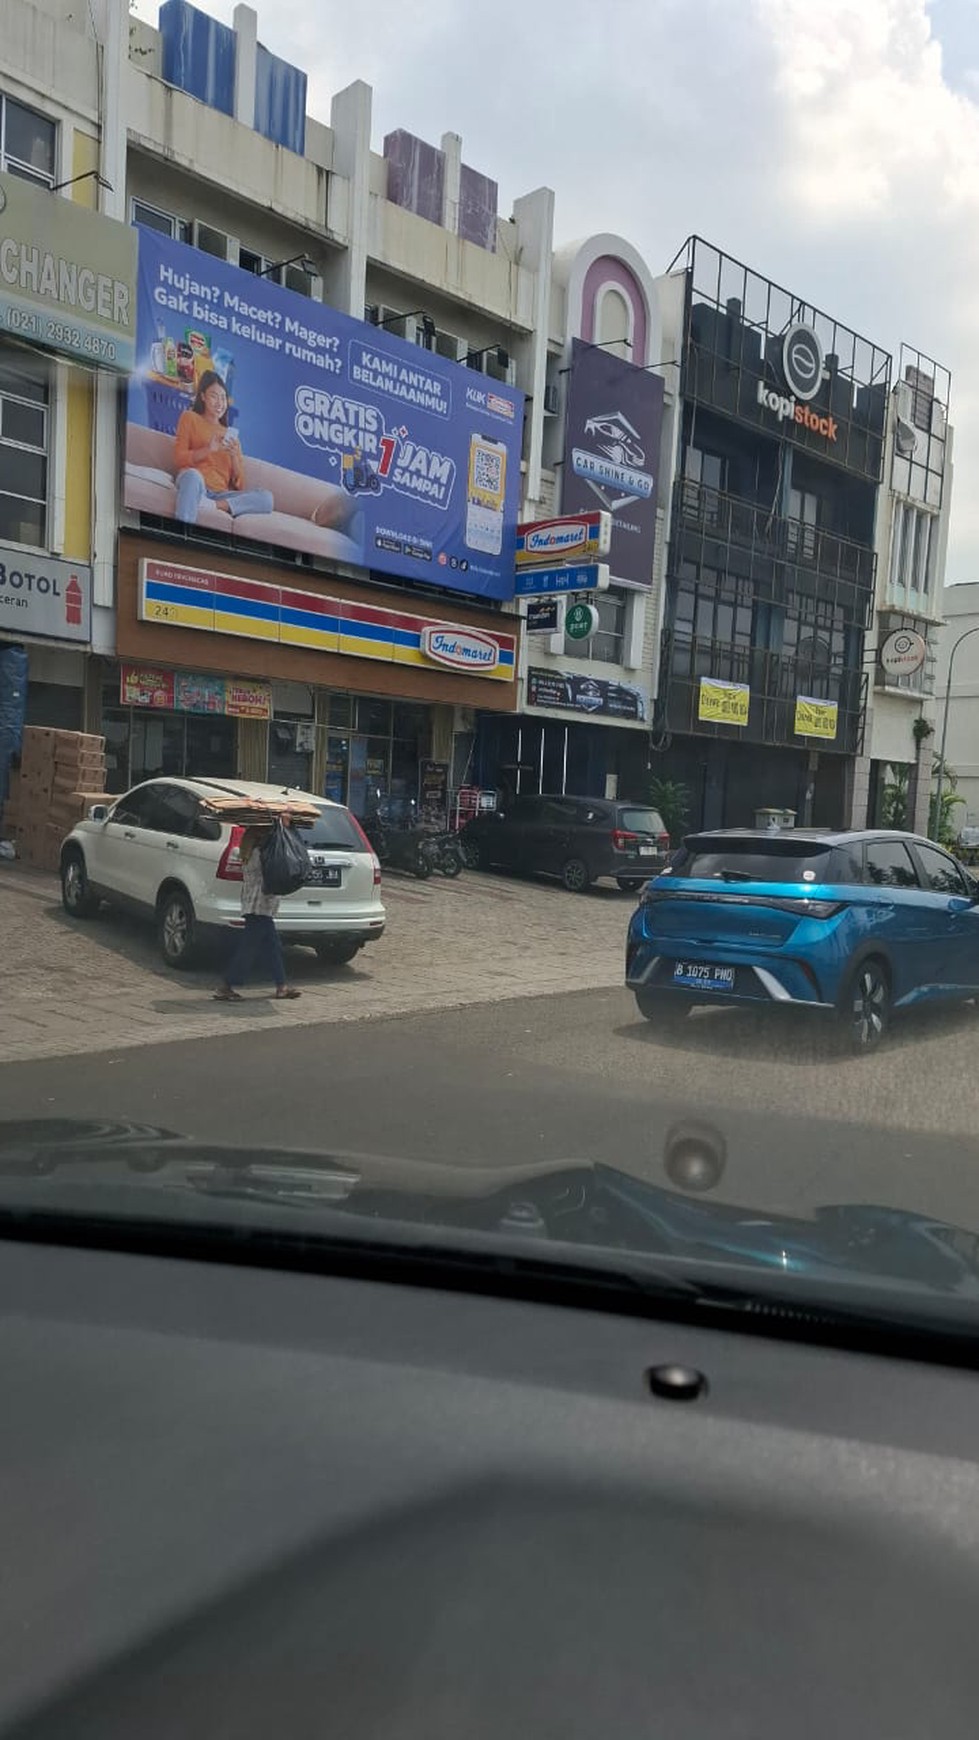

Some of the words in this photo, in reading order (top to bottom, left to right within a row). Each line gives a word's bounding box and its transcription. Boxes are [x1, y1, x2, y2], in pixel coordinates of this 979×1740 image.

[1, 239, 129, 325] CHANGER
[159, 265, 220, 303] Hujan?
[223, 292, 281, 329] Macet?
[285, 318, 340, 352] Mager?
[8, 307, 42, 337] (021)
[47, 321, 80, 348] 2932
[85, 336, 116, 360] 4870
[154, 288, 189, 314] Gak
[192, 301, 228, 330] bisa
[232, 317, 282, 350] keluar
[285, 342, 343, 374] rumah?
[353, 366, 447, 414] BELANJAANMU!
[362, 352, 397, 376] KAMI
[402, 367, 441, 396] ANTAR
[297, 389, 378, 431] GRATIS
[757, 380, 838, 441] kopistock
[297, 414, 378, 455] ONGKIR
[393, 469, 445, 500] SAMPAI
[398, 443, 450, 490] JAM
[576, 456, 595, 470] CAR
[599, 465, 625, 481] SHINE
[637, 479, 650, 490] GO
[529, 527, 584, 548] Indomaret
[432, 634, 494, 662] Indomaret
[686, 964, 710, 979] 1075
